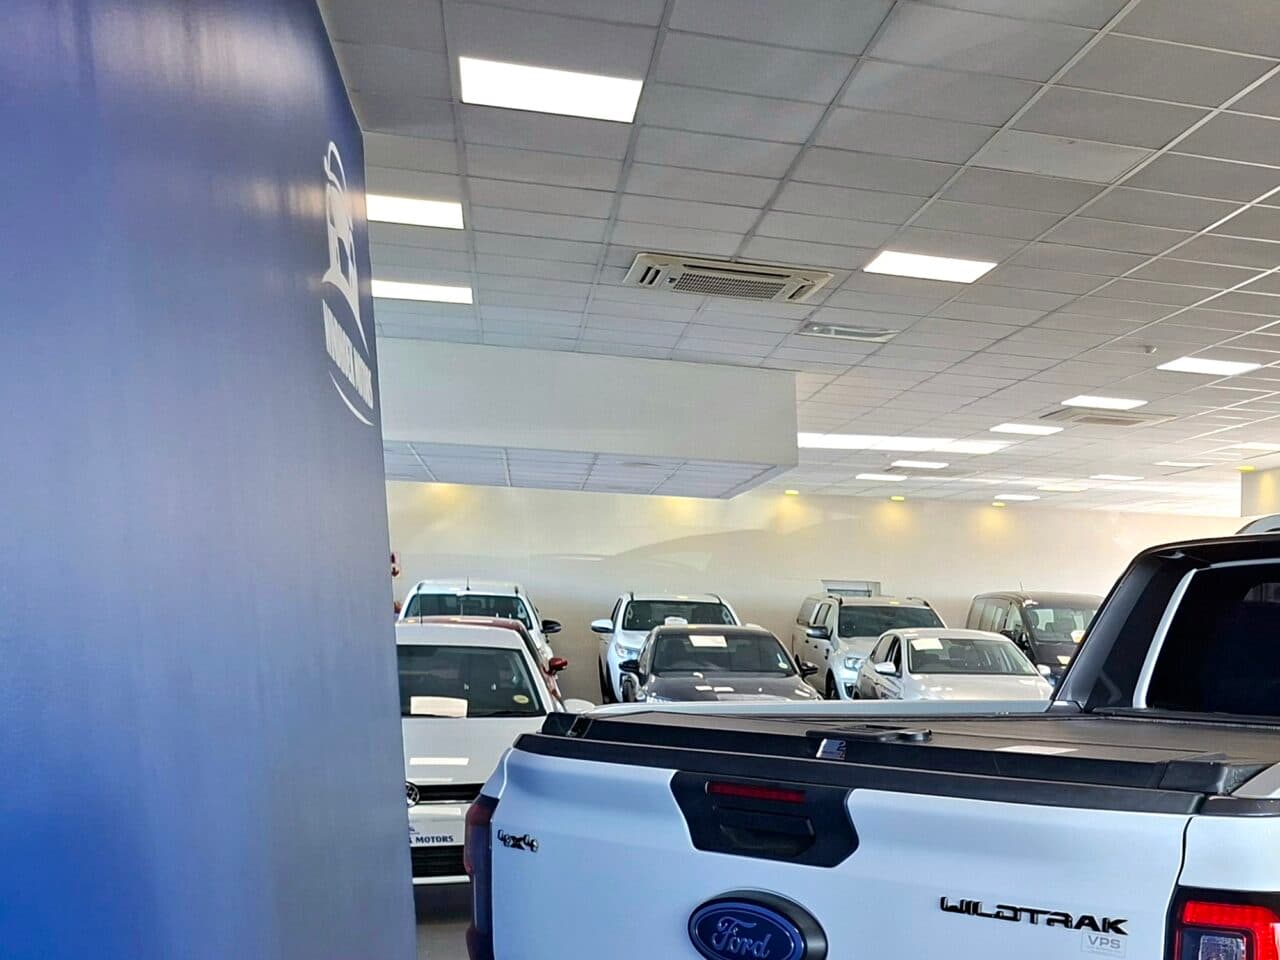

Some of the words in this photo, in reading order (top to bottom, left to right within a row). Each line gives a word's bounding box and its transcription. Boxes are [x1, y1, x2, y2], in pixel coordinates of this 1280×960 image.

[415, 835, 454, 844] MOTORS
[940, 896, 1129, 936] WILDTRAK
[711, 915, 772, 959] Ford
[1087, 934, 1121, 950] VPS
